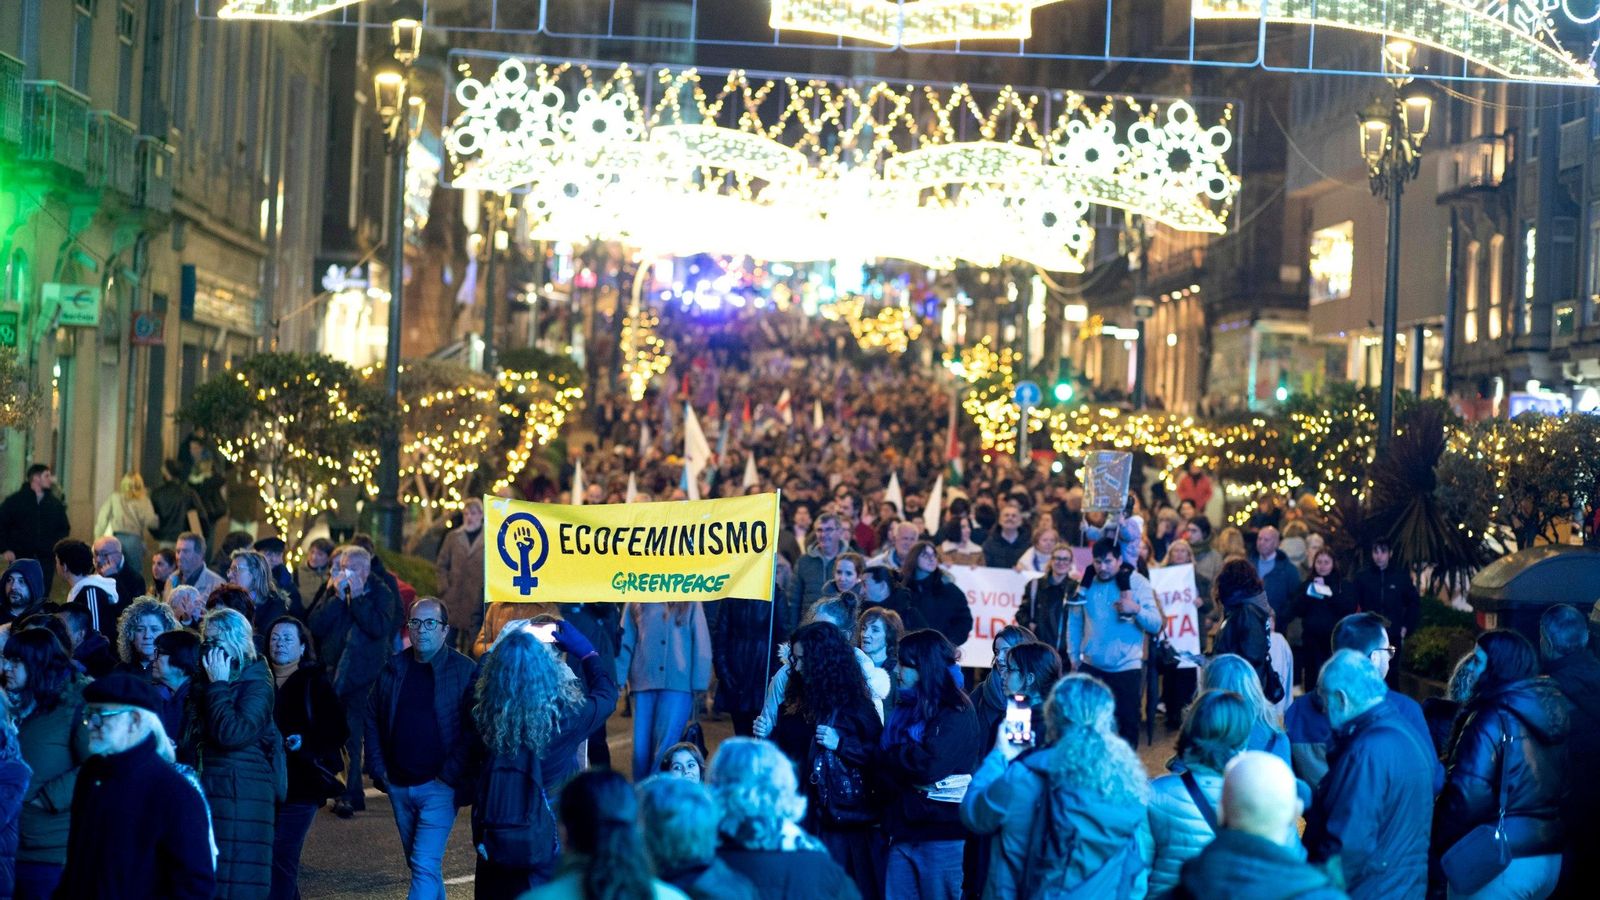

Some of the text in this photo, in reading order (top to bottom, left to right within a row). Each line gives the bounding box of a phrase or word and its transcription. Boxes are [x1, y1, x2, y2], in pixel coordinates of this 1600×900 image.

[559, 520, 768, 556] ECOFEMINISMO
[611, 571, 730, 594] GREENPEACE
[966, 587, 1193, 608] S VIOL TAS
[970, 613, 1198, 640] LD TA
